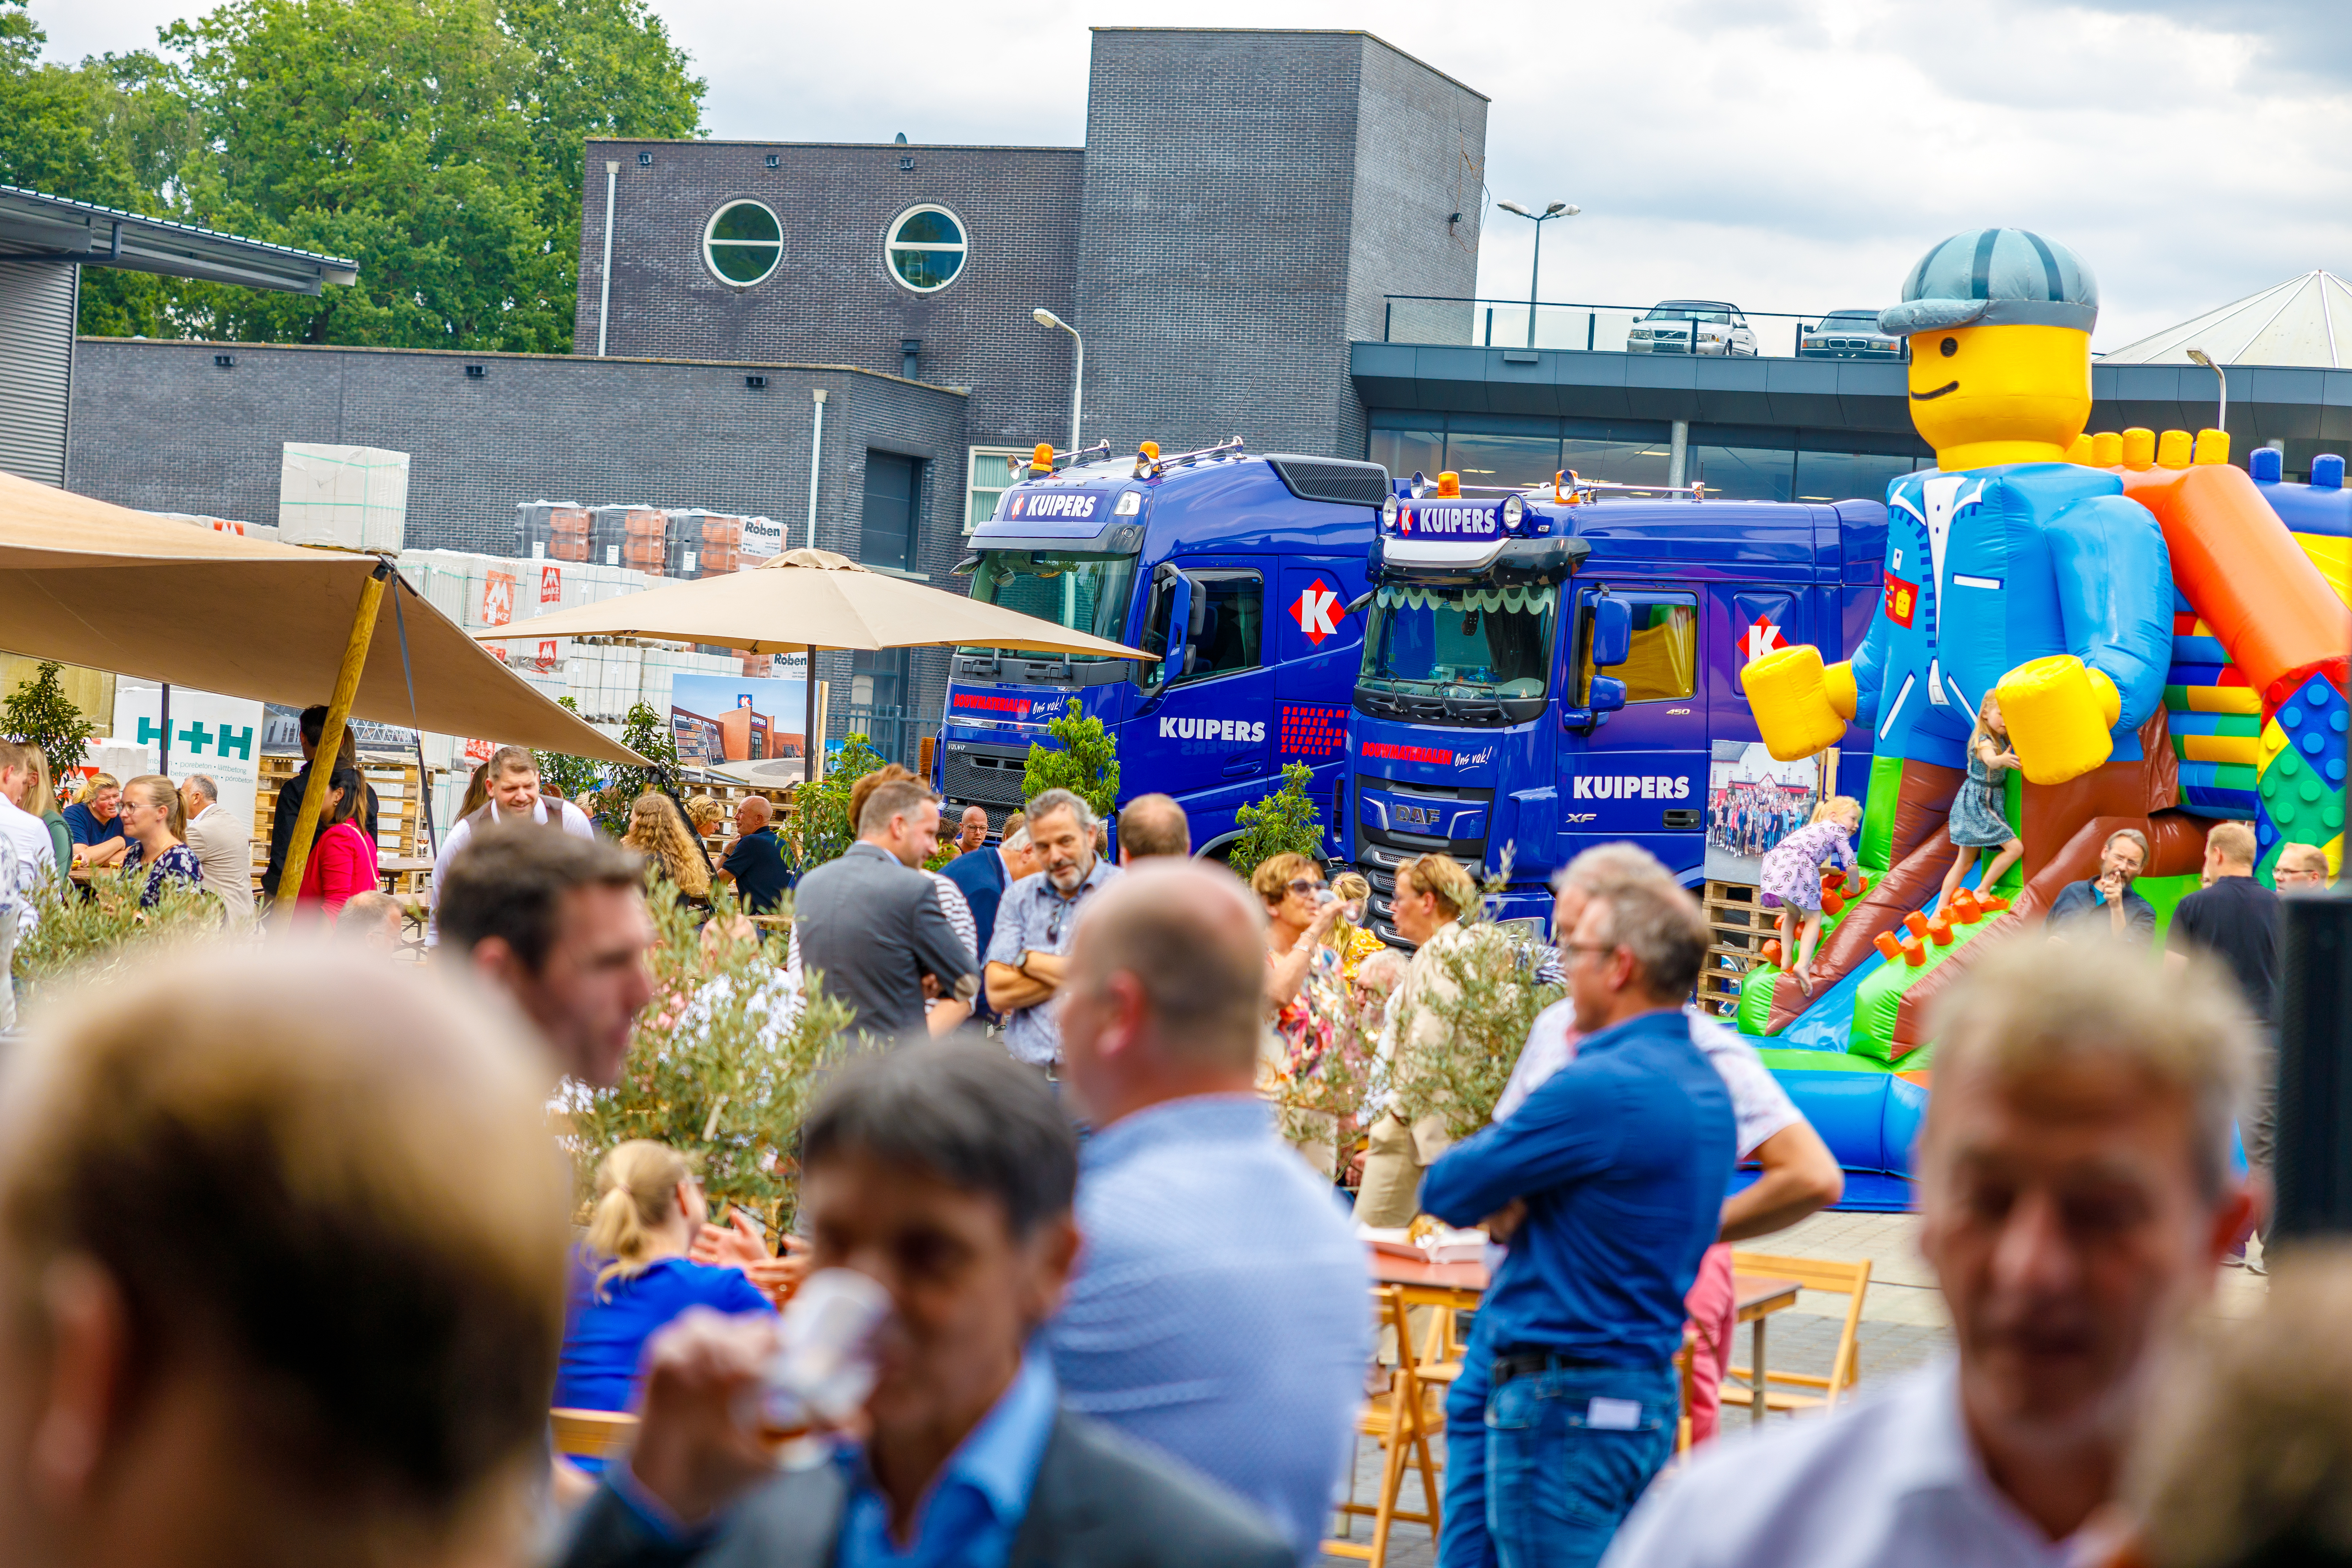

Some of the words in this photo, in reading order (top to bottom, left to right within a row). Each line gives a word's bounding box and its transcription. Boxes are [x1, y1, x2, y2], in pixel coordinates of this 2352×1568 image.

[1011, 497, 1025, 515] K
[1026, 495, 1097, 517] KUIPERS
[745, 520, 780, 536] Röben
[1402, 510, 1411, 530] K
[1420, 508, 1496, 534] KUIPERS
[543, 586, 560, 596] MAKZ
[1301, 589, 1338, 634] K
[774, 653, 807, 666] Röben
[953, 694, 1031, 713] BOUWMATERIALEN
[1033, 702, 1045, 714] Ons
[1047, 695, 1065, 711] vak!
[1159, 717, 1265, 742] KUIPERS
[1282, 716, 1328, 726] EMMEN
[137, 717, 253, 760] H+H
[1281, 735, 1342, 746] VEENDAM
[1280, 744, 1331, 755] ZWOLLE
[1361, 742, 1453, 765] BOUWMATERIALEN
[1455, 753, 1470, 767] Ons
[1472, 746, 1493, 764] vak!
[217, 764, 247, 775] lättbetong
[225, 775, 253, 784] pórobeton
[1573, 776, 1690, 799] KUIPERS
[1395, 804, 1440, 825] DAF
[1565, 813, 1597, 823] XF
